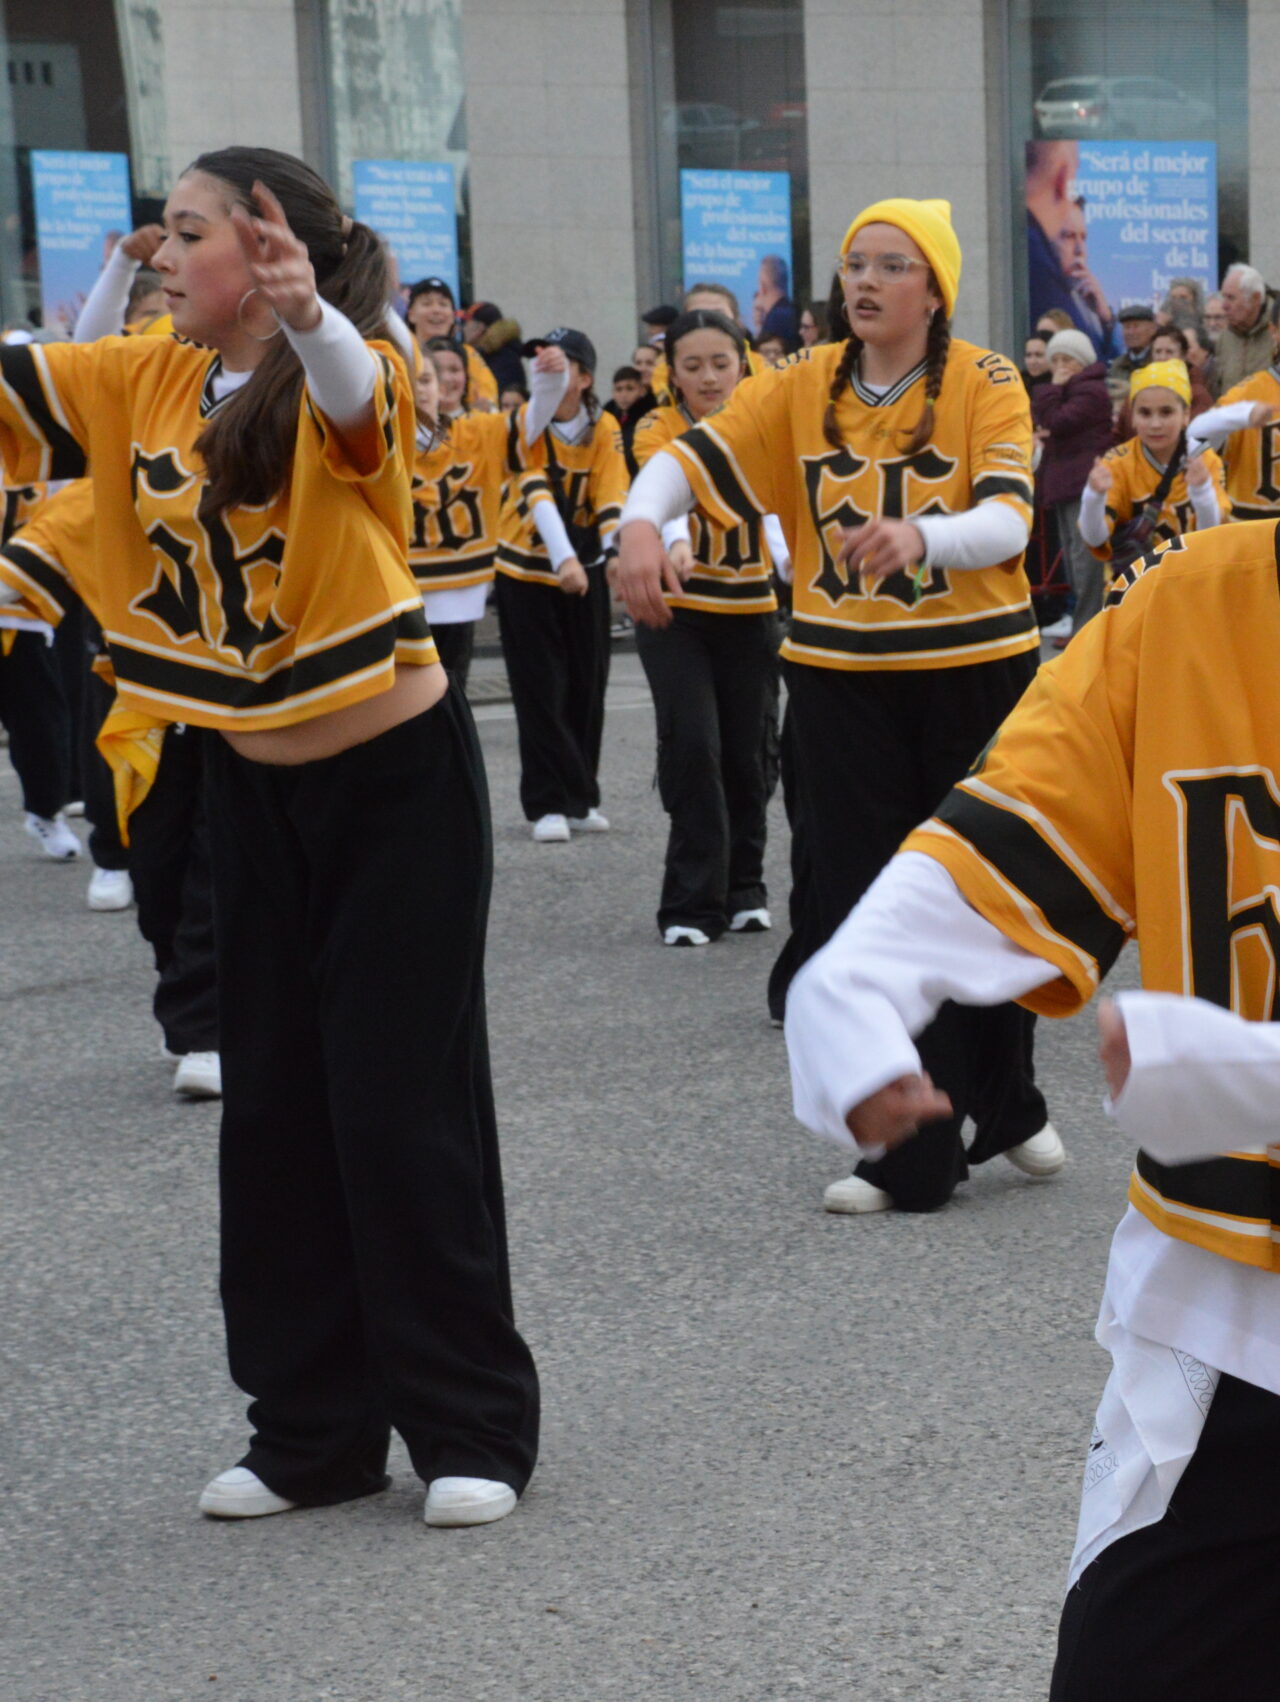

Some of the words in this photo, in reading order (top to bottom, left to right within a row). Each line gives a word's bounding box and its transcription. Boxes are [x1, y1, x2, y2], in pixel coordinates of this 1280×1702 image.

[1133, 150, 1148, 172] el
[1153, 152, 1208, 179] mejor
[1067, 178, 1123, 202] grupo
[1126, 174, 1149, 196] de
[1085, 197, 1208, 224] profesionales
[1121, 221, 1148, 243] del
[1152, 224, 1208, 246] sector
[1165, 246, 1189, 268] de
[1191, 246, 1208, 268] la
